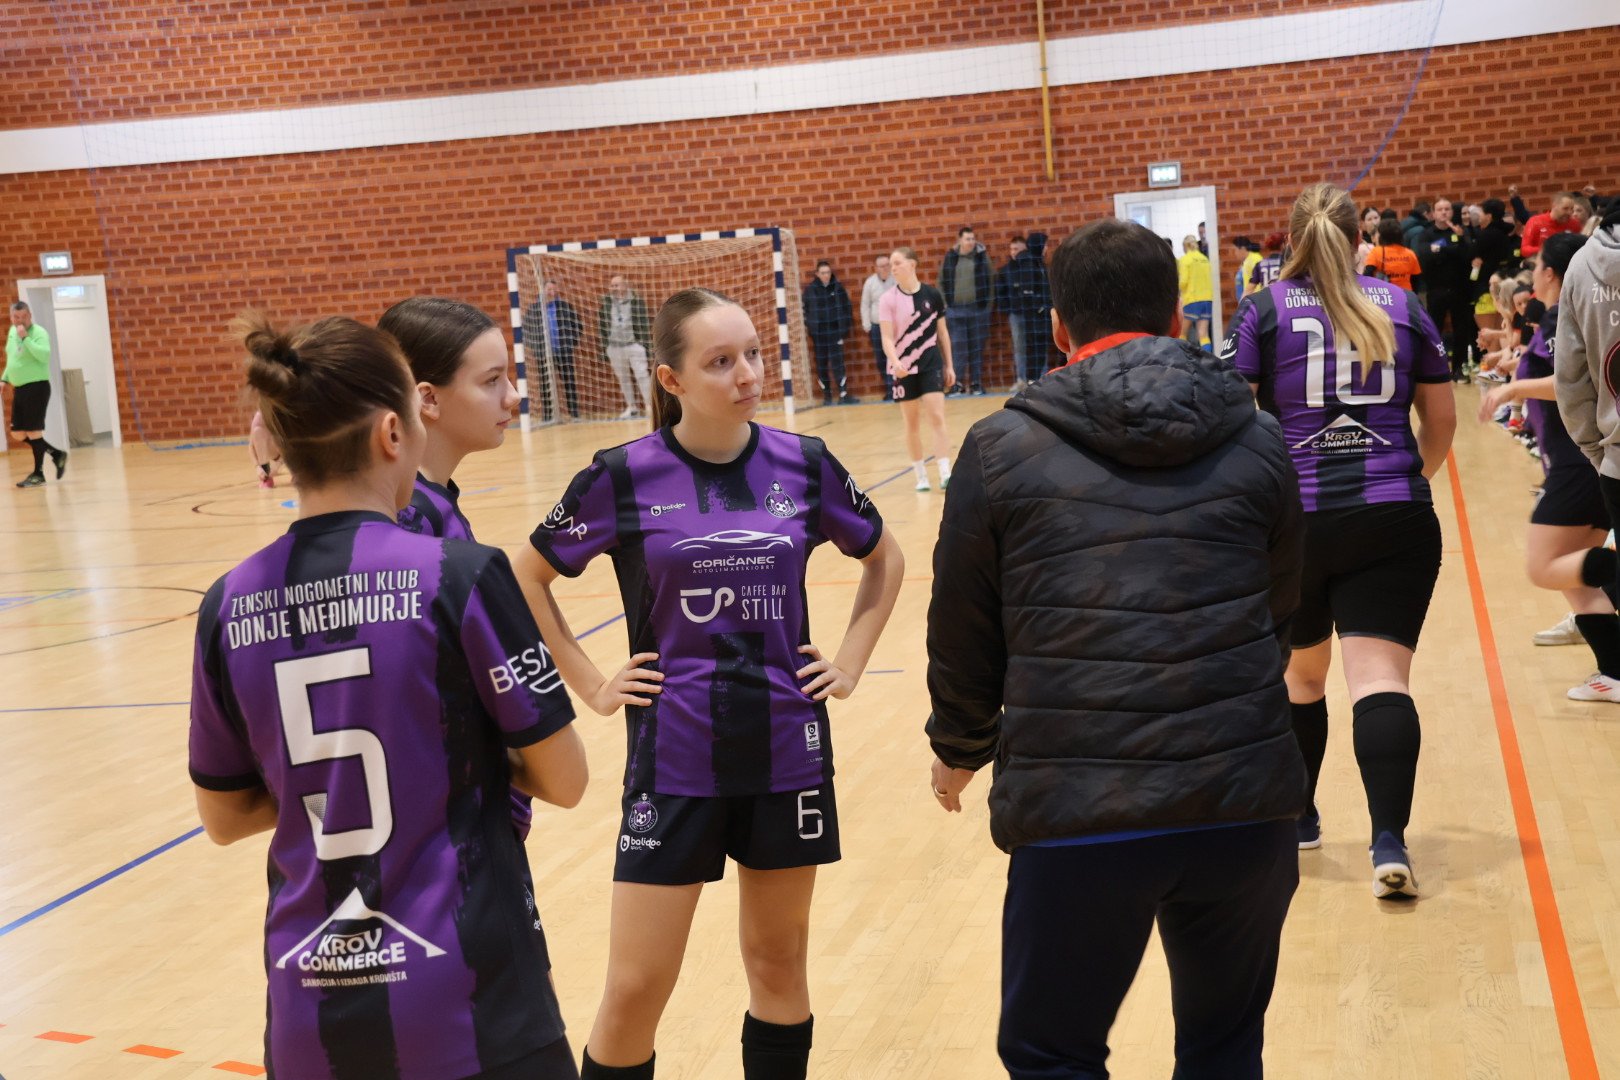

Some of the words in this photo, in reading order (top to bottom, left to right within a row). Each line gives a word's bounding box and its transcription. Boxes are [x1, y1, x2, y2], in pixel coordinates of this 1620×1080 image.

[1367, 286, 1390, 295] KLUB
[1592, 282, 1620, 304] ŽNK
[1284, 295, 1323, 309] DONJE
[1311, 438, 1373, 449] COMMERCE
[1324, 431, 1362, 441] KROV
[692, 555, 775, 568] GORIČANEC
[284, 572, 369, 606] NOGOMETNI
[376, 569, 419, 592] KLUB
[741, 585, 767, 597] CAFFE
[771, 584, 787, 596] BAR
[742, 598, 784, 620] STILL
[227, 610, 291, 650] DONJE
[299, 591, 422, 635] MEĐIMURJE
[274, 647, 393, 861] 5
[798, 789, 824, 840] 6
[317, 927, 383, 956] KROV
[298, 941, 406, 972] COMMERCE
[302, 977, 337, 988] SANACIJA
[369, 970, 407, 984] KROVIŠTA
